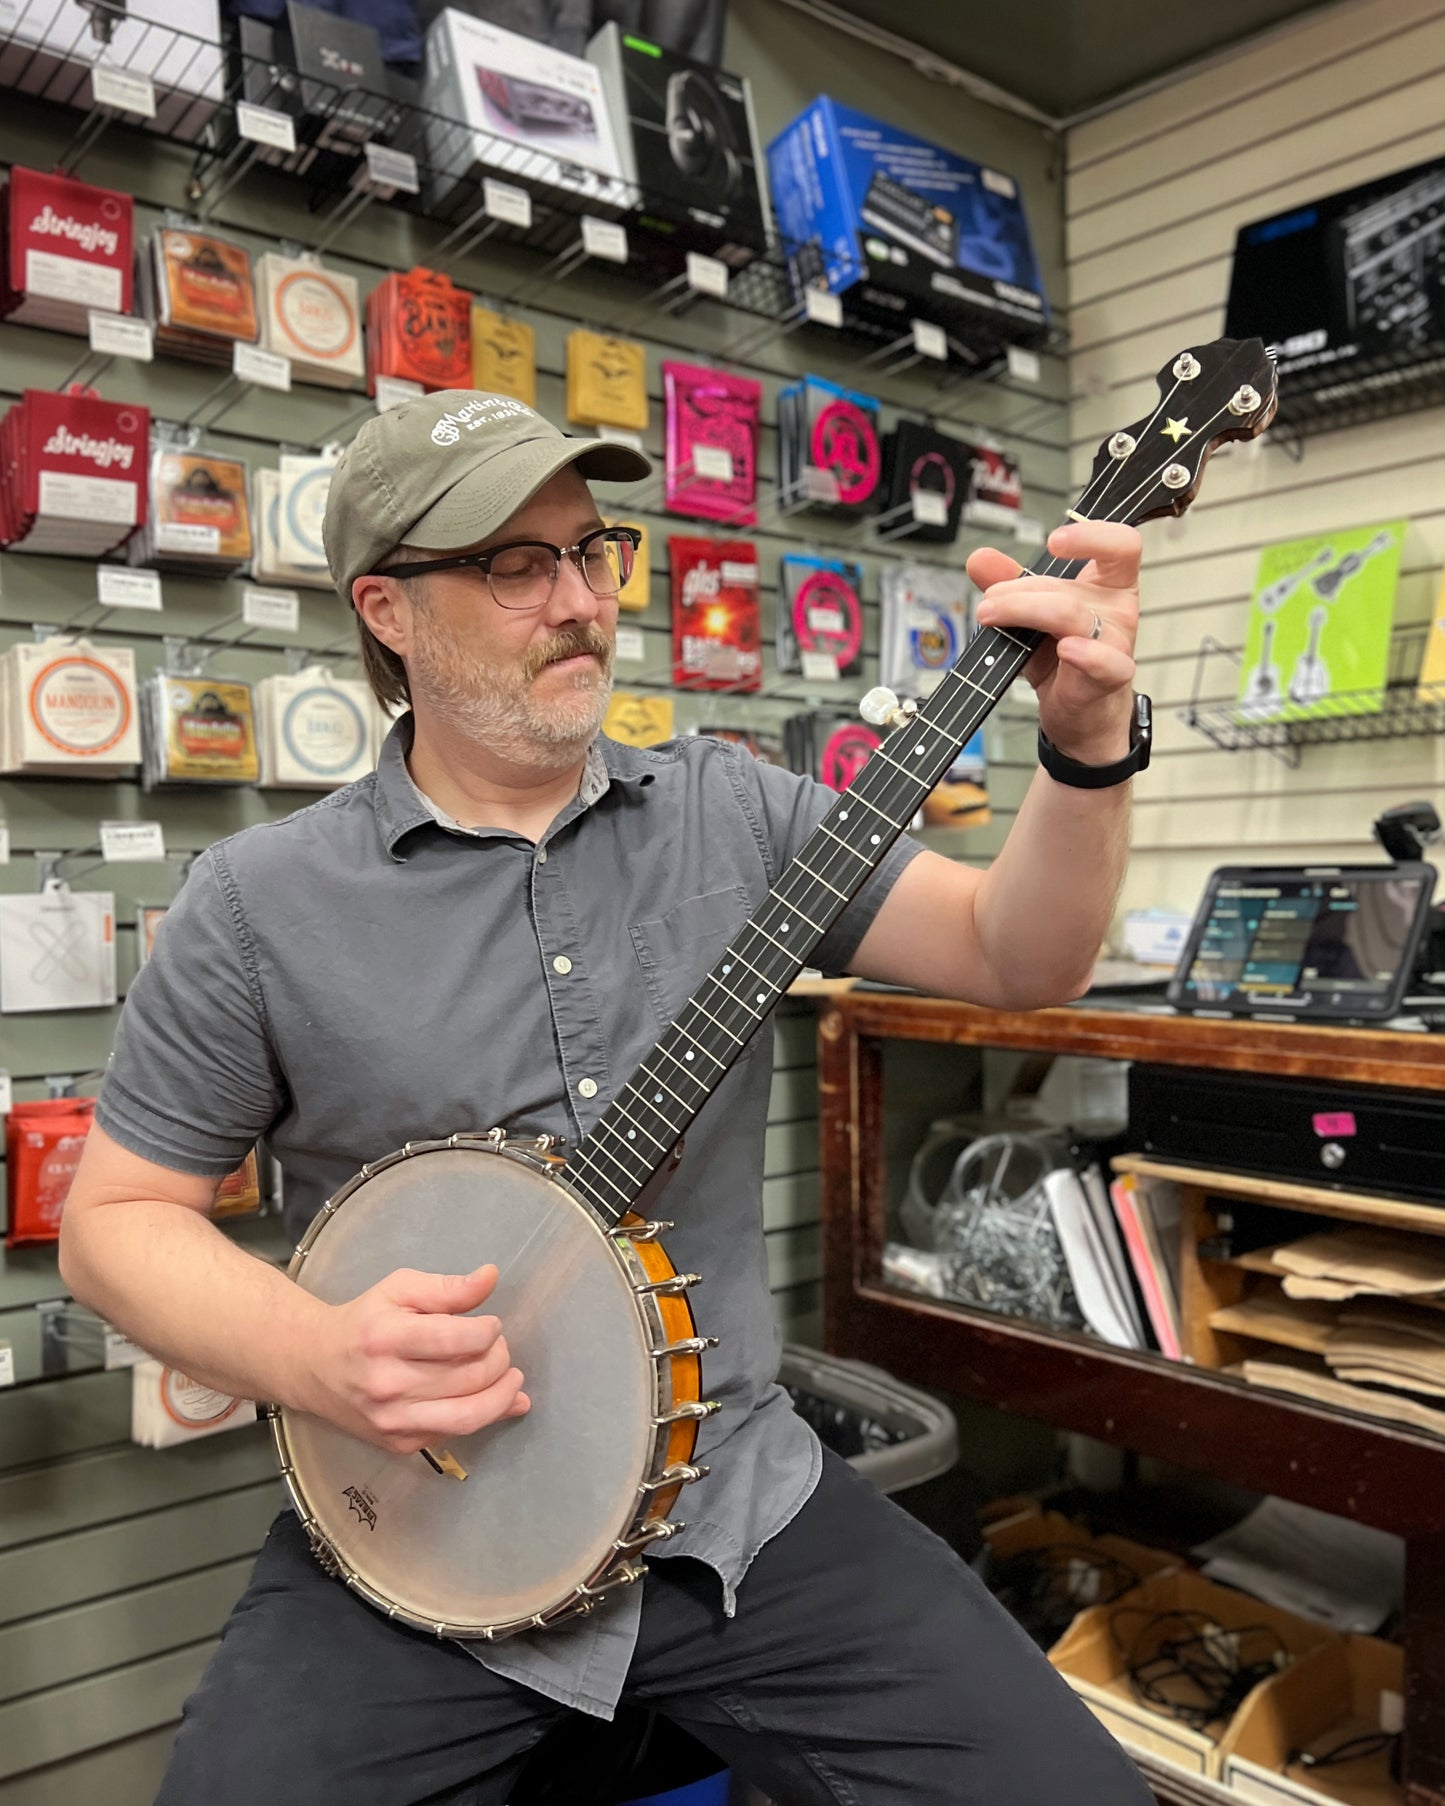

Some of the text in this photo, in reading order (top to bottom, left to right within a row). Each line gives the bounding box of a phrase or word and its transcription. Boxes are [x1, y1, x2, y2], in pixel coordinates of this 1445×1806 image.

[29, 205, 118, 255] Stringjoy
[443, 399, 497, 425] Martin
[43, 424, 135, 470] Stringjoy
[45, 693, 117, 710] MANDOLIN
